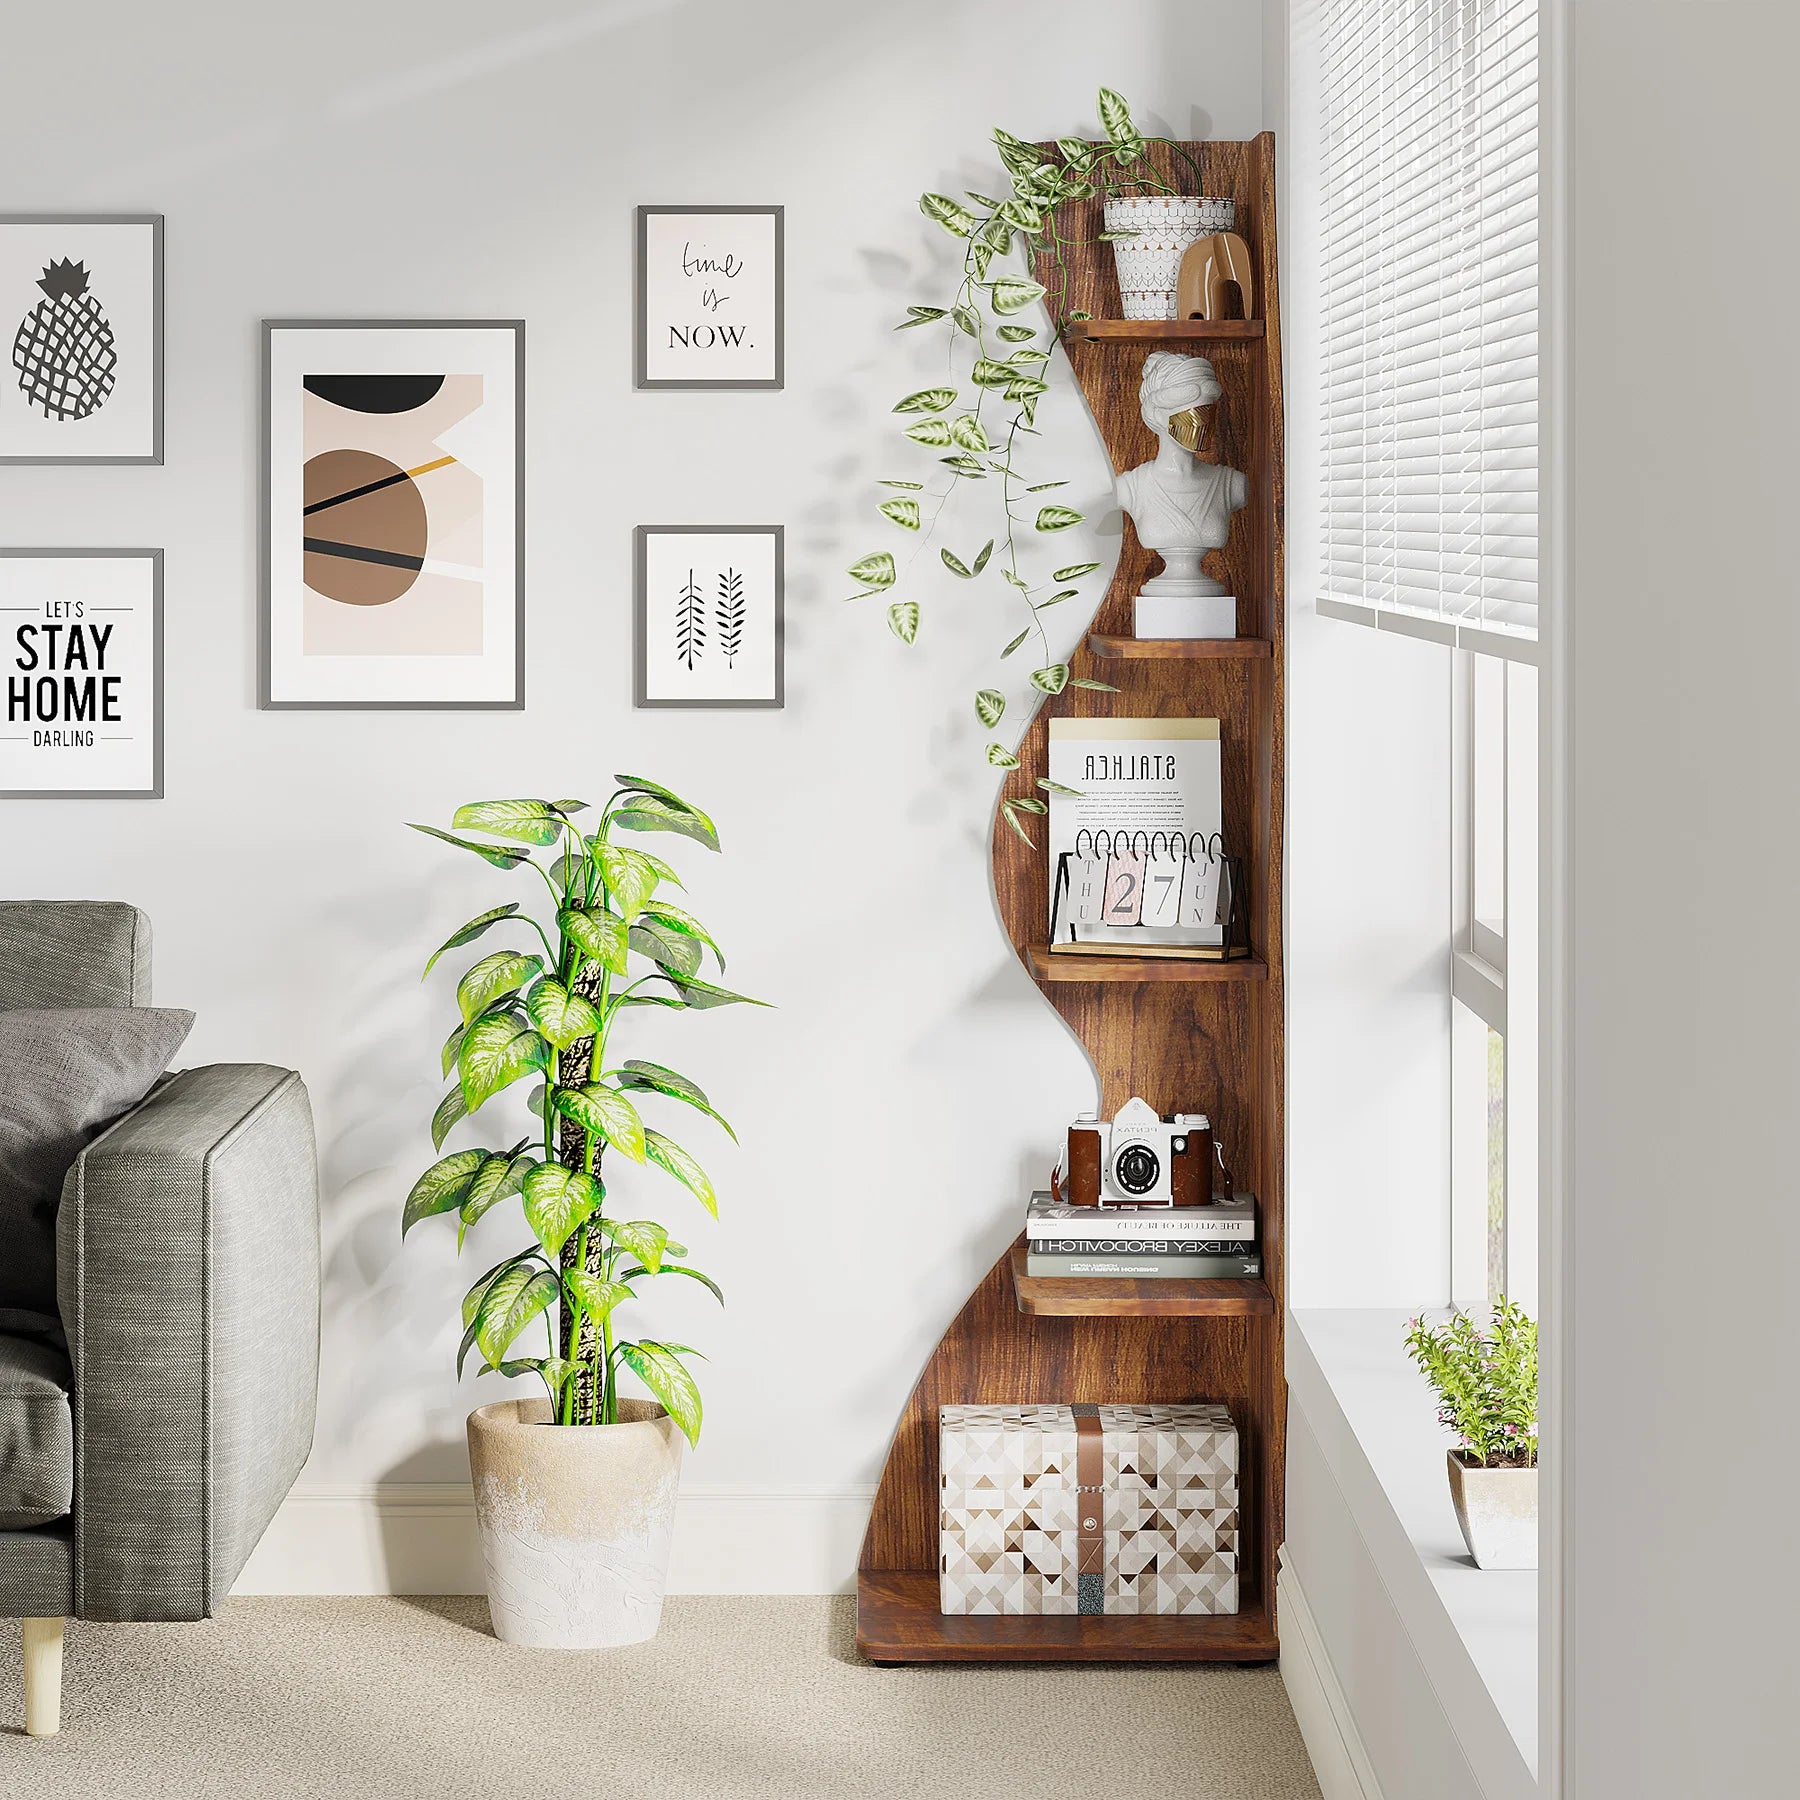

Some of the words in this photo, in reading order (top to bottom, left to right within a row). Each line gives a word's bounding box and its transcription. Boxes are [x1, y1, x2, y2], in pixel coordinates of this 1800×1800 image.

[682, 241, 743, 278] time
[702, 282, 730, 312] is
[668, 325, 754, 349] NOW.
[46, 601, 84, 618] LET'S
[16, 624, 114, 671] STAY
[8, 676, 122, 722] HOME
[34, 730, 94, 747] DARLING
